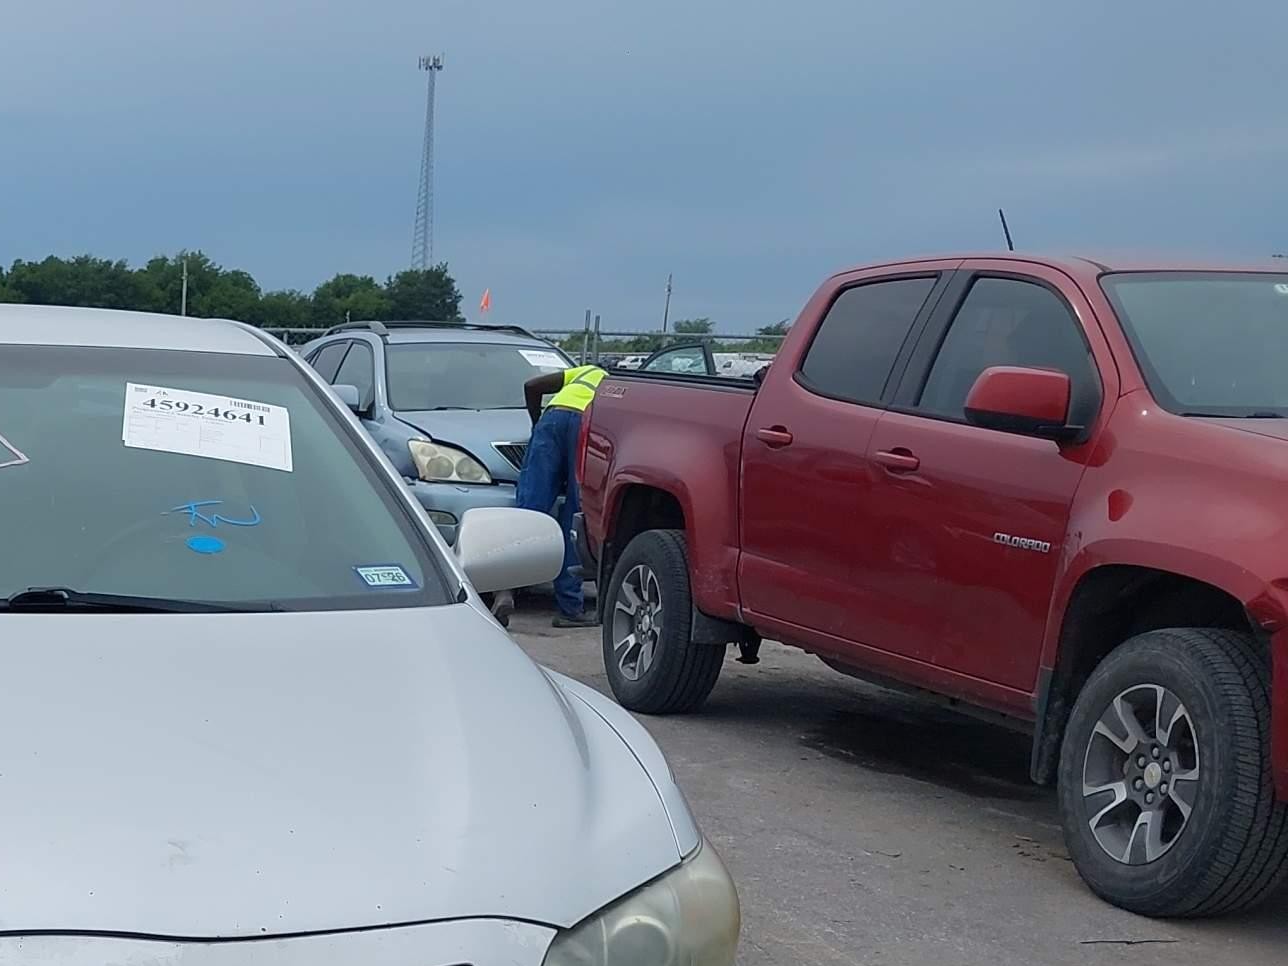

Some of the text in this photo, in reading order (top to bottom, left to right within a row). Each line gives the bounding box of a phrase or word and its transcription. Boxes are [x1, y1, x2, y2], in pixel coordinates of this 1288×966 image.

[142, 397, 266, 426] 45924641
[993, 532, 1051, 553] COLORADO
[364, 572, 382, 583] 07
